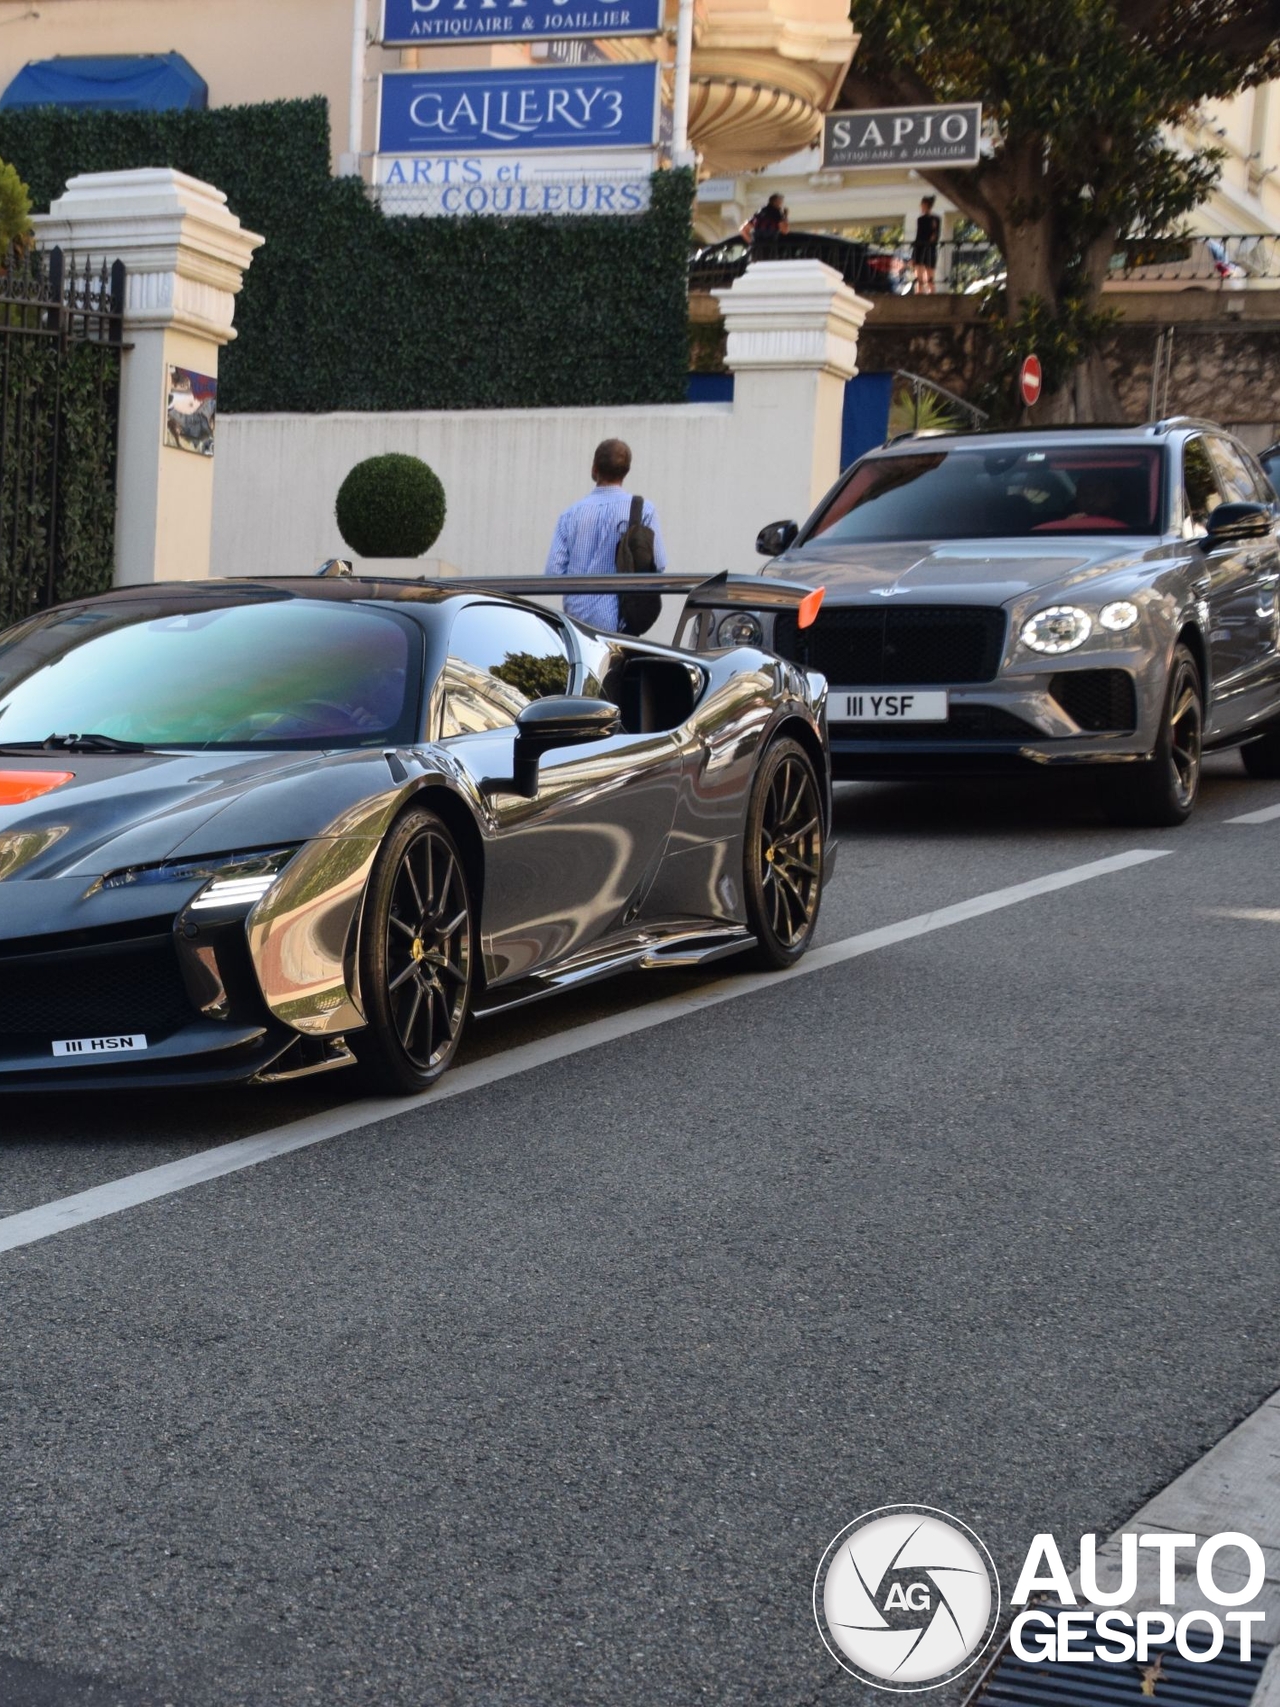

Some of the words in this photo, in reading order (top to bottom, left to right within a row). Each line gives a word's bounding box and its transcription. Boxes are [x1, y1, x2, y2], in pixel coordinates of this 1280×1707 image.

[410, 16, 513, 35] ANTIQUAIRE
[522, 16, 535, 30] &
[544, 10, 631, 29] JOAILLIER
[832, 114, 968, 149] SAPJO
[386, 158, 482, 184] ARTS
[497, 163, 523, 183] et
[441, 184, 642, 212] COULEURS
[870, 696, 914, 716] YSF
[91, 1037, 133, 1050] HSN
